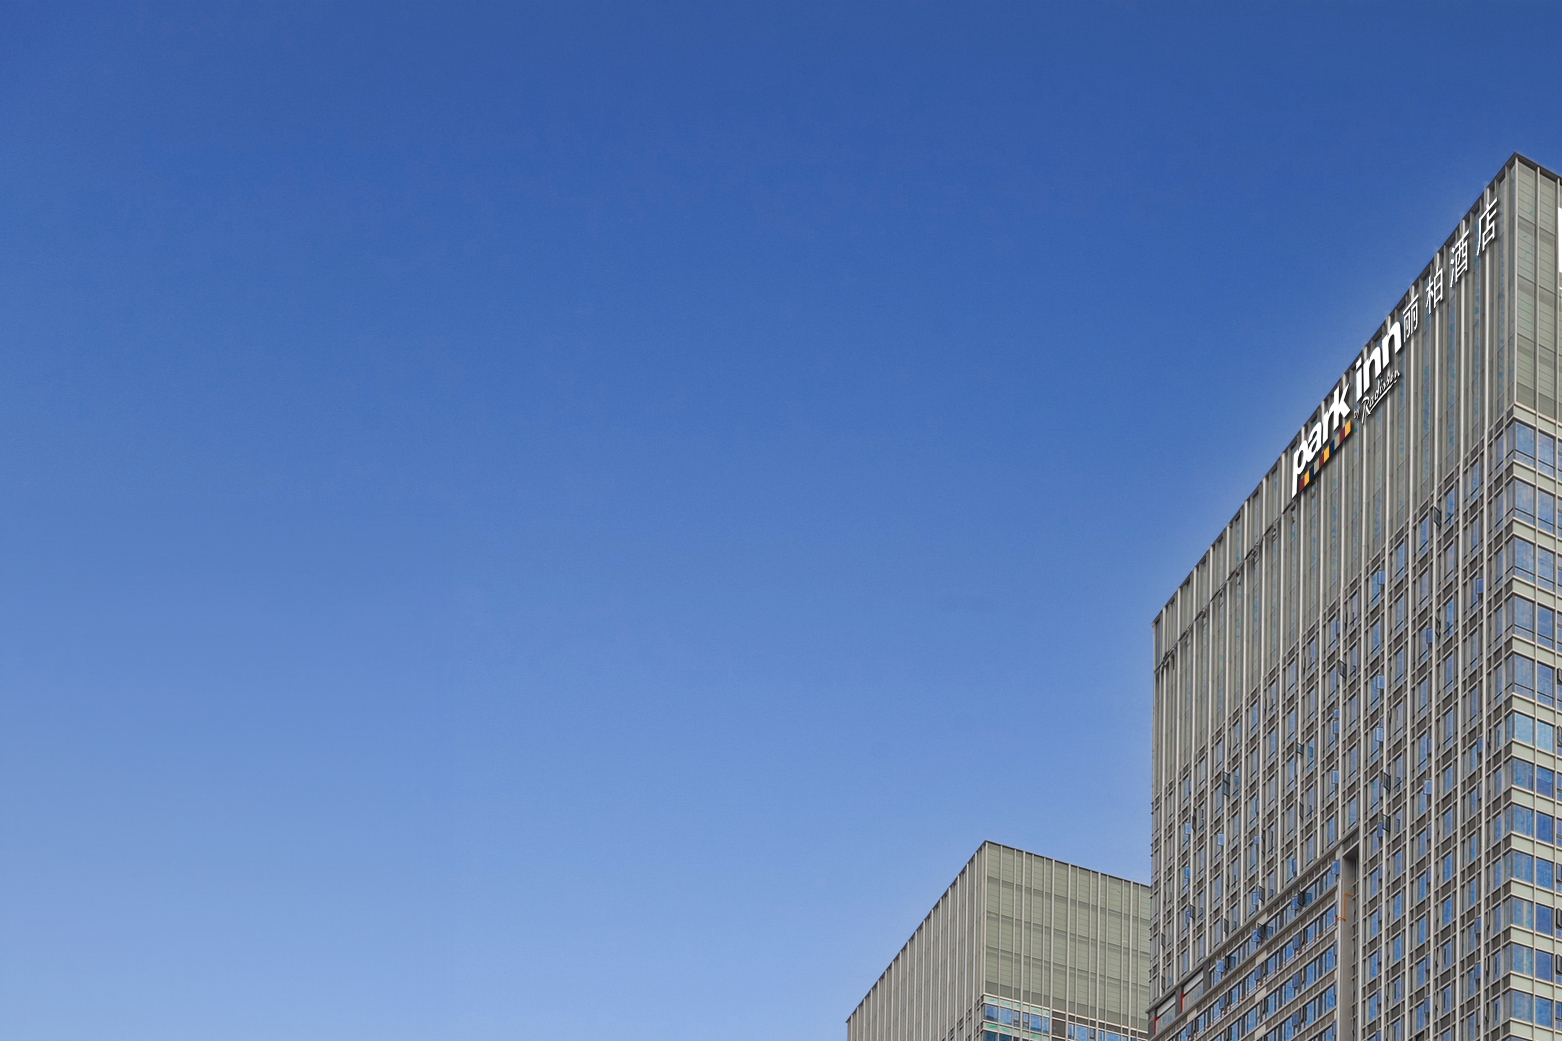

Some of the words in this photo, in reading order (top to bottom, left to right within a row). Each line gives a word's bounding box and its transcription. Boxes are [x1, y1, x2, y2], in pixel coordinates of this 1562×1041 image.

[1402, 197, 1497, 343] 丽柏酒店
[1291, 383, 1351, 499] park
[1355, 321, 1402, 403] inn
